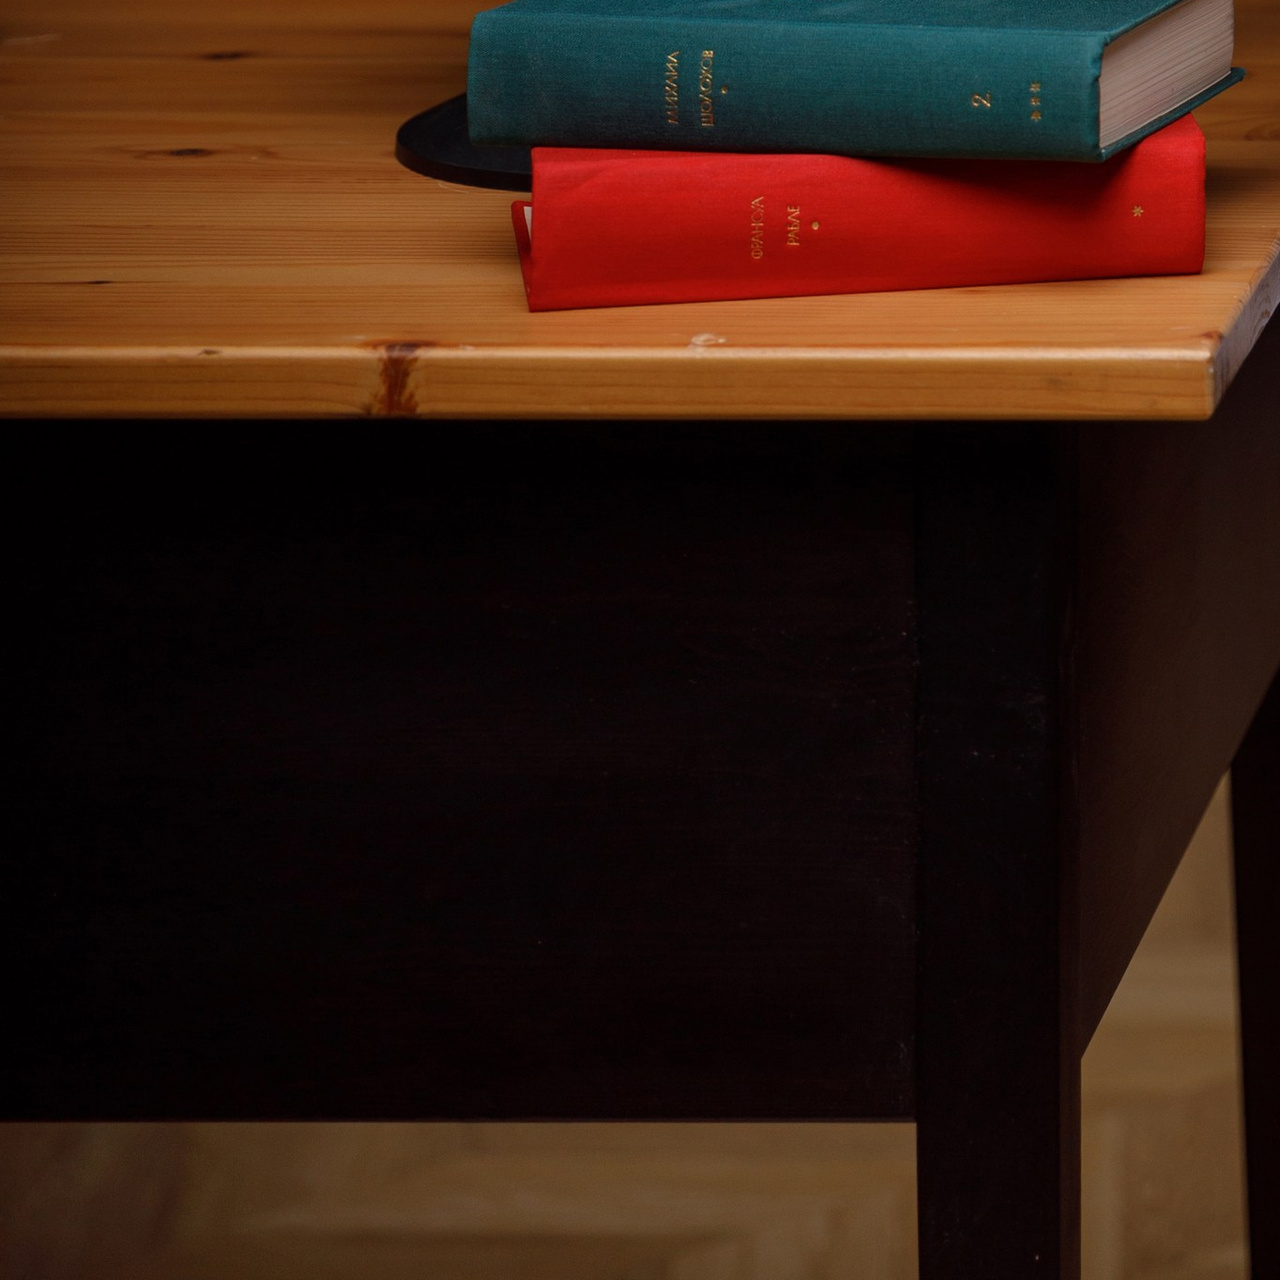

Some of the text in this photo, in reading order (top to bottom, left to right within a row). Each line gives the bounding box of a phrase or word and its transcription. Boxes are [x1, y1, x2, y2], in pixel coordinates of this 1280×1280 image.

[664, 50, 681, 124] МИХАИЛ
[699, 50, 715, 127] ШОЛОХОВ
[971, 92, 991, 108] 2
[751, 196, 764, 260] ФРАНСУА
[787, 205, 800, 246] РАБЛЕ
